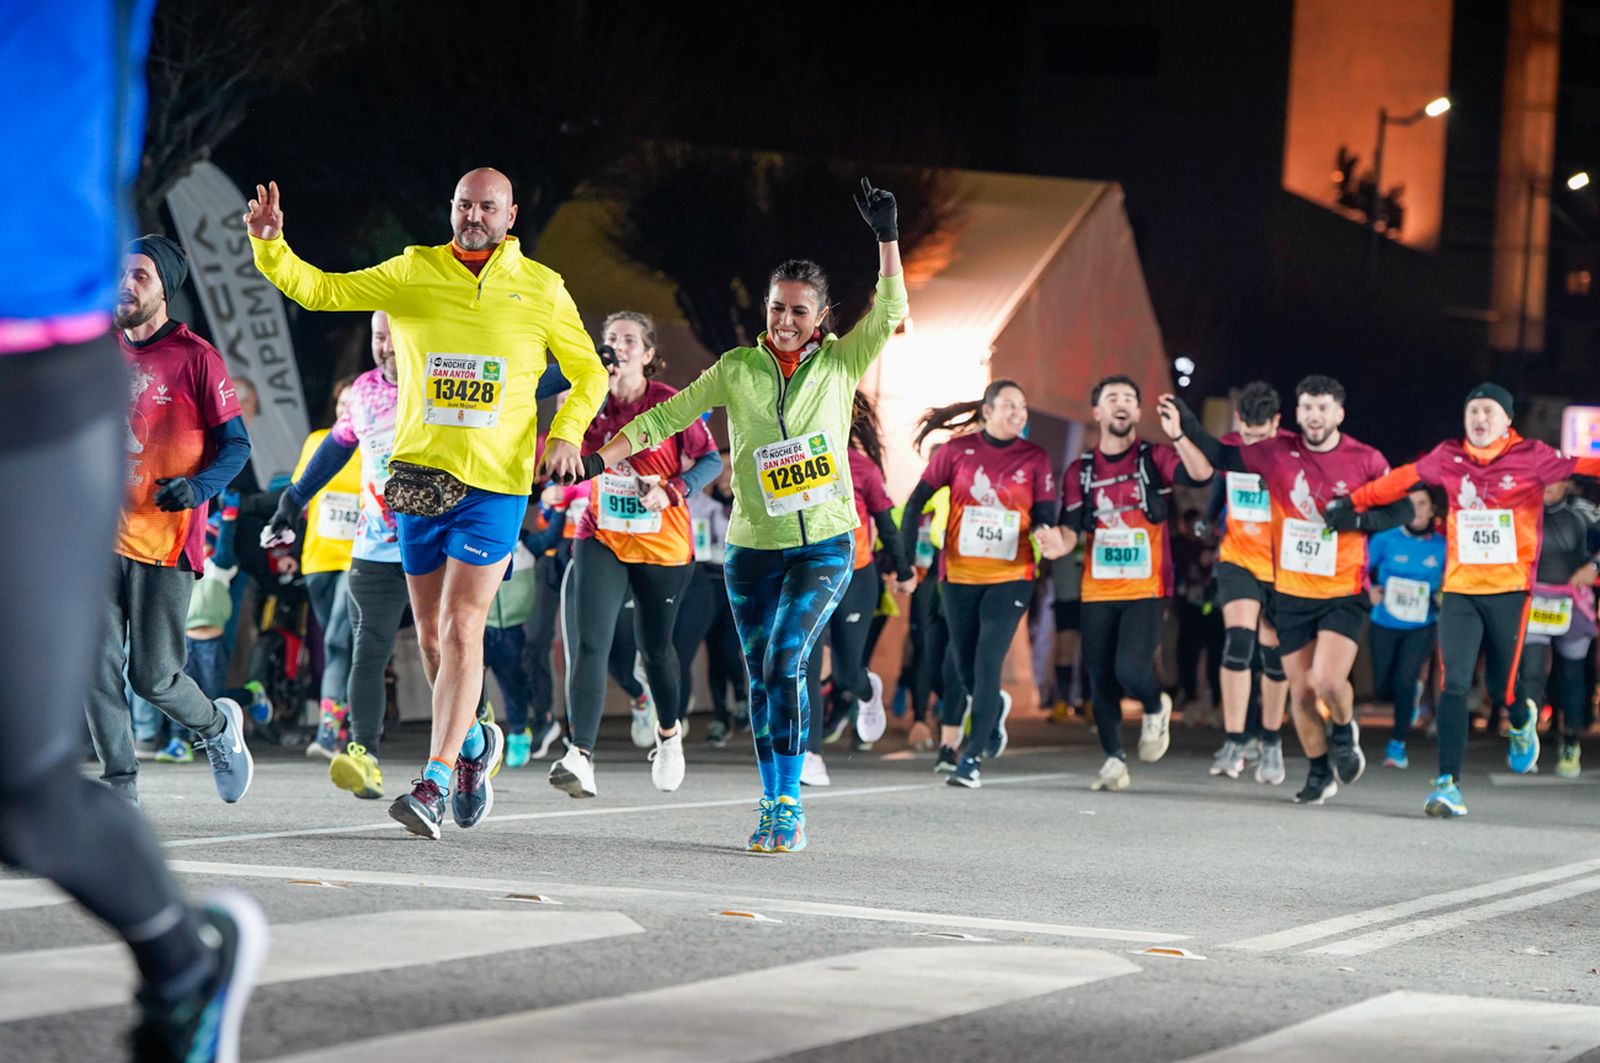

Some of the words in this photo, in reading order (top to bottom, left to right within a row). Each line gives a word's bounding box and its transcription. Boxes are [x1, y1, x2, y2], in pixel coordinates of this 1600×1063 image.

[222, 207, 299, 409] JAPEMASA
[433, 368, 448, 377] SAN
[442, 361, 465, 369] NOCHE
[467, 362, 477, 370] DE
[433, 378, 495, 404] 13428
[769, 447, 793, 460] NOCHE
[793, 443, 803, 452] DE
[616, 462, 632, 477] 43
[763, 460, 779, 470] SAN
[767, 455, 831, 491] 12846
[976, 526, 1003, 542] 454
[1473, 530, 1500, 544] 456
[1105, 547, 1139, 562] 8307
[1296, 540, 1320, 556] 457
